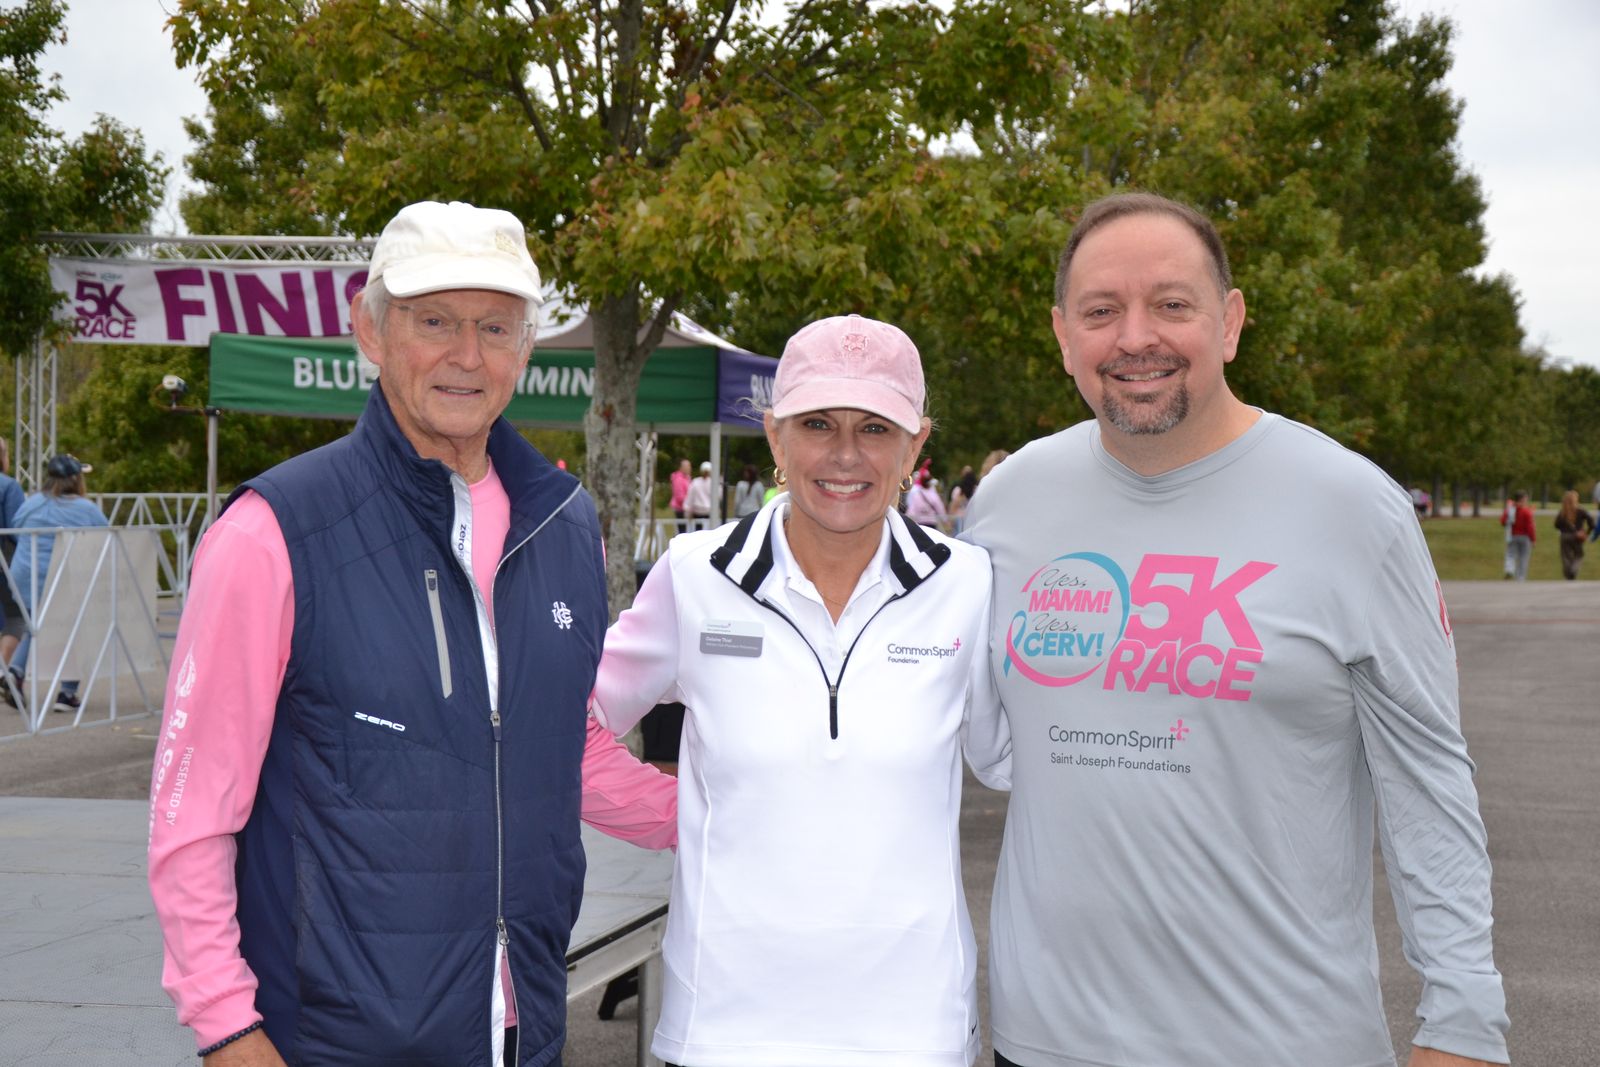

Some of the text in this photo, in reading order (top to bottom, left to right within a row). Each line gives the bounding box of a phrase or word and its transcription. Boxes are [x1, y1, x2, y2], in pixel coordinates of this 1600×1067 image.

[75, 280, 136, 319] 5K
[73, 316, 137, 338] RACE
[1028, 588, 1114, 614] MAMM!
[1124, 553, 1279, 651] 5K
[887, 643, 956, 659] CommonSpirit
[1023, 631, 1105, 657] CERV!
[887, 656, 920, 664] Foundation
[1103, 638, 1264, 701] RACE
[354, 711, 406, 732] ZERO
[1048, 725, 1176, 752] CommonSpirit
[1050, 752, 1191, 773] Saint Joseph Foundations
[165, 746, 194, 826] PRESENTED BY
